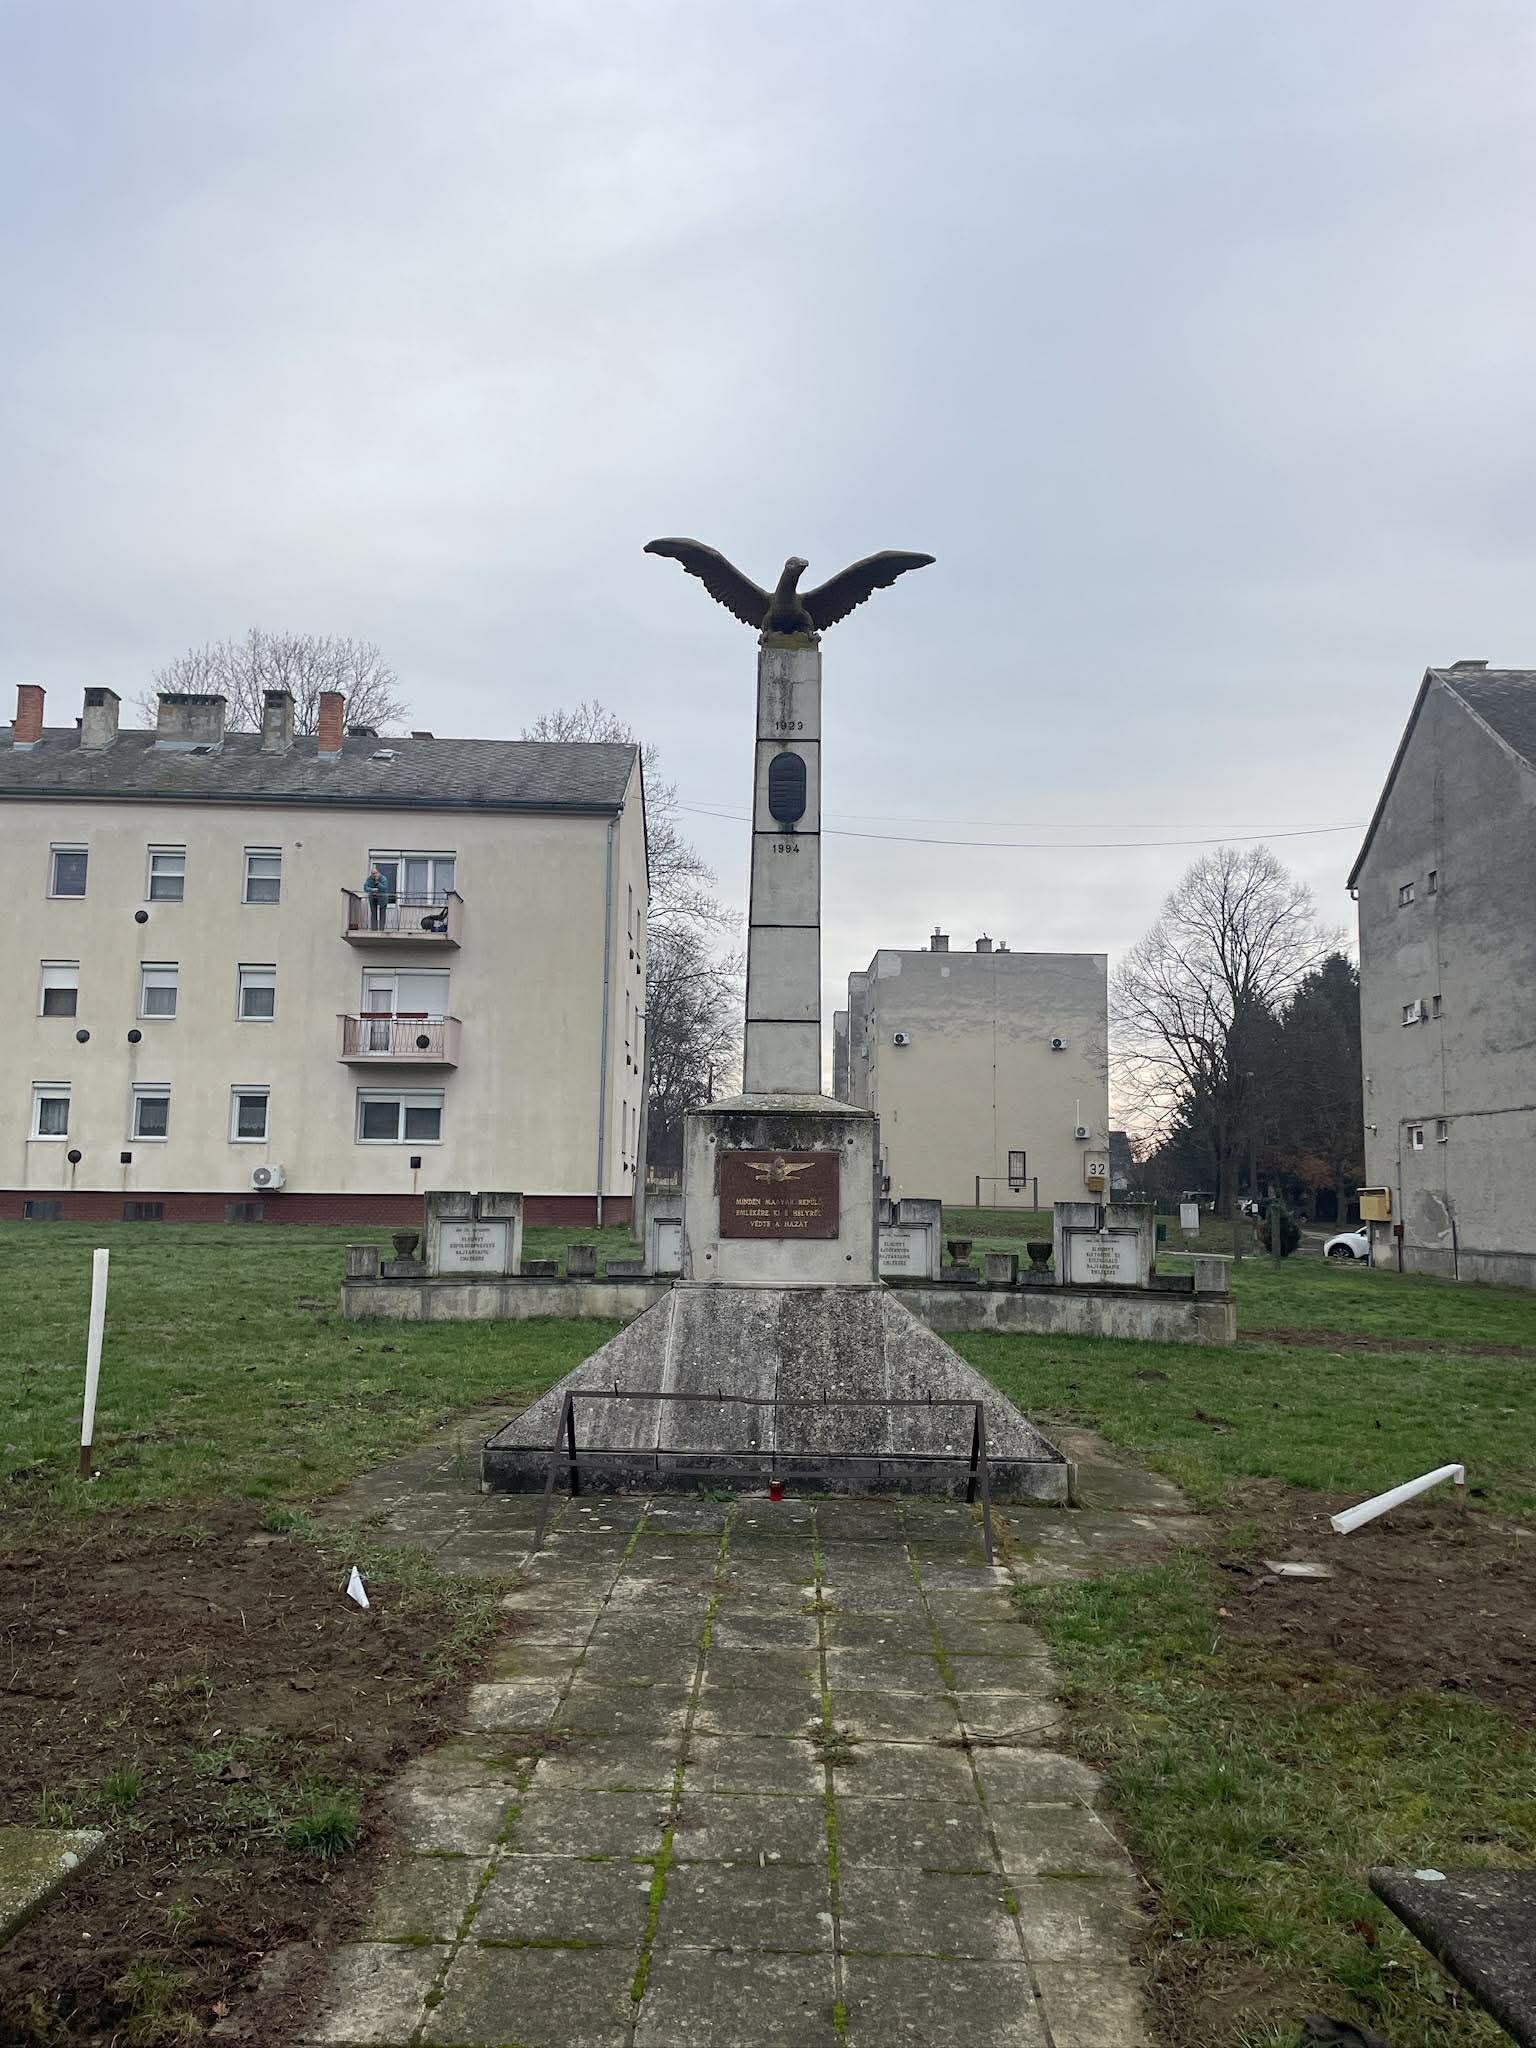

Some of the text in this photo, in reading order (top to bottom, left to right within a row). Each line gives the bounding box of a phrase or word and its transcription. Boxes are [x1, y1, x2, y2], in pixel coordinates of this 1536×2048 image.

[773, 844, 800, 854] 1994
[1090, 1163, 1105, 1175] 32
[736, 1198, 761, 1206] MINDEN
